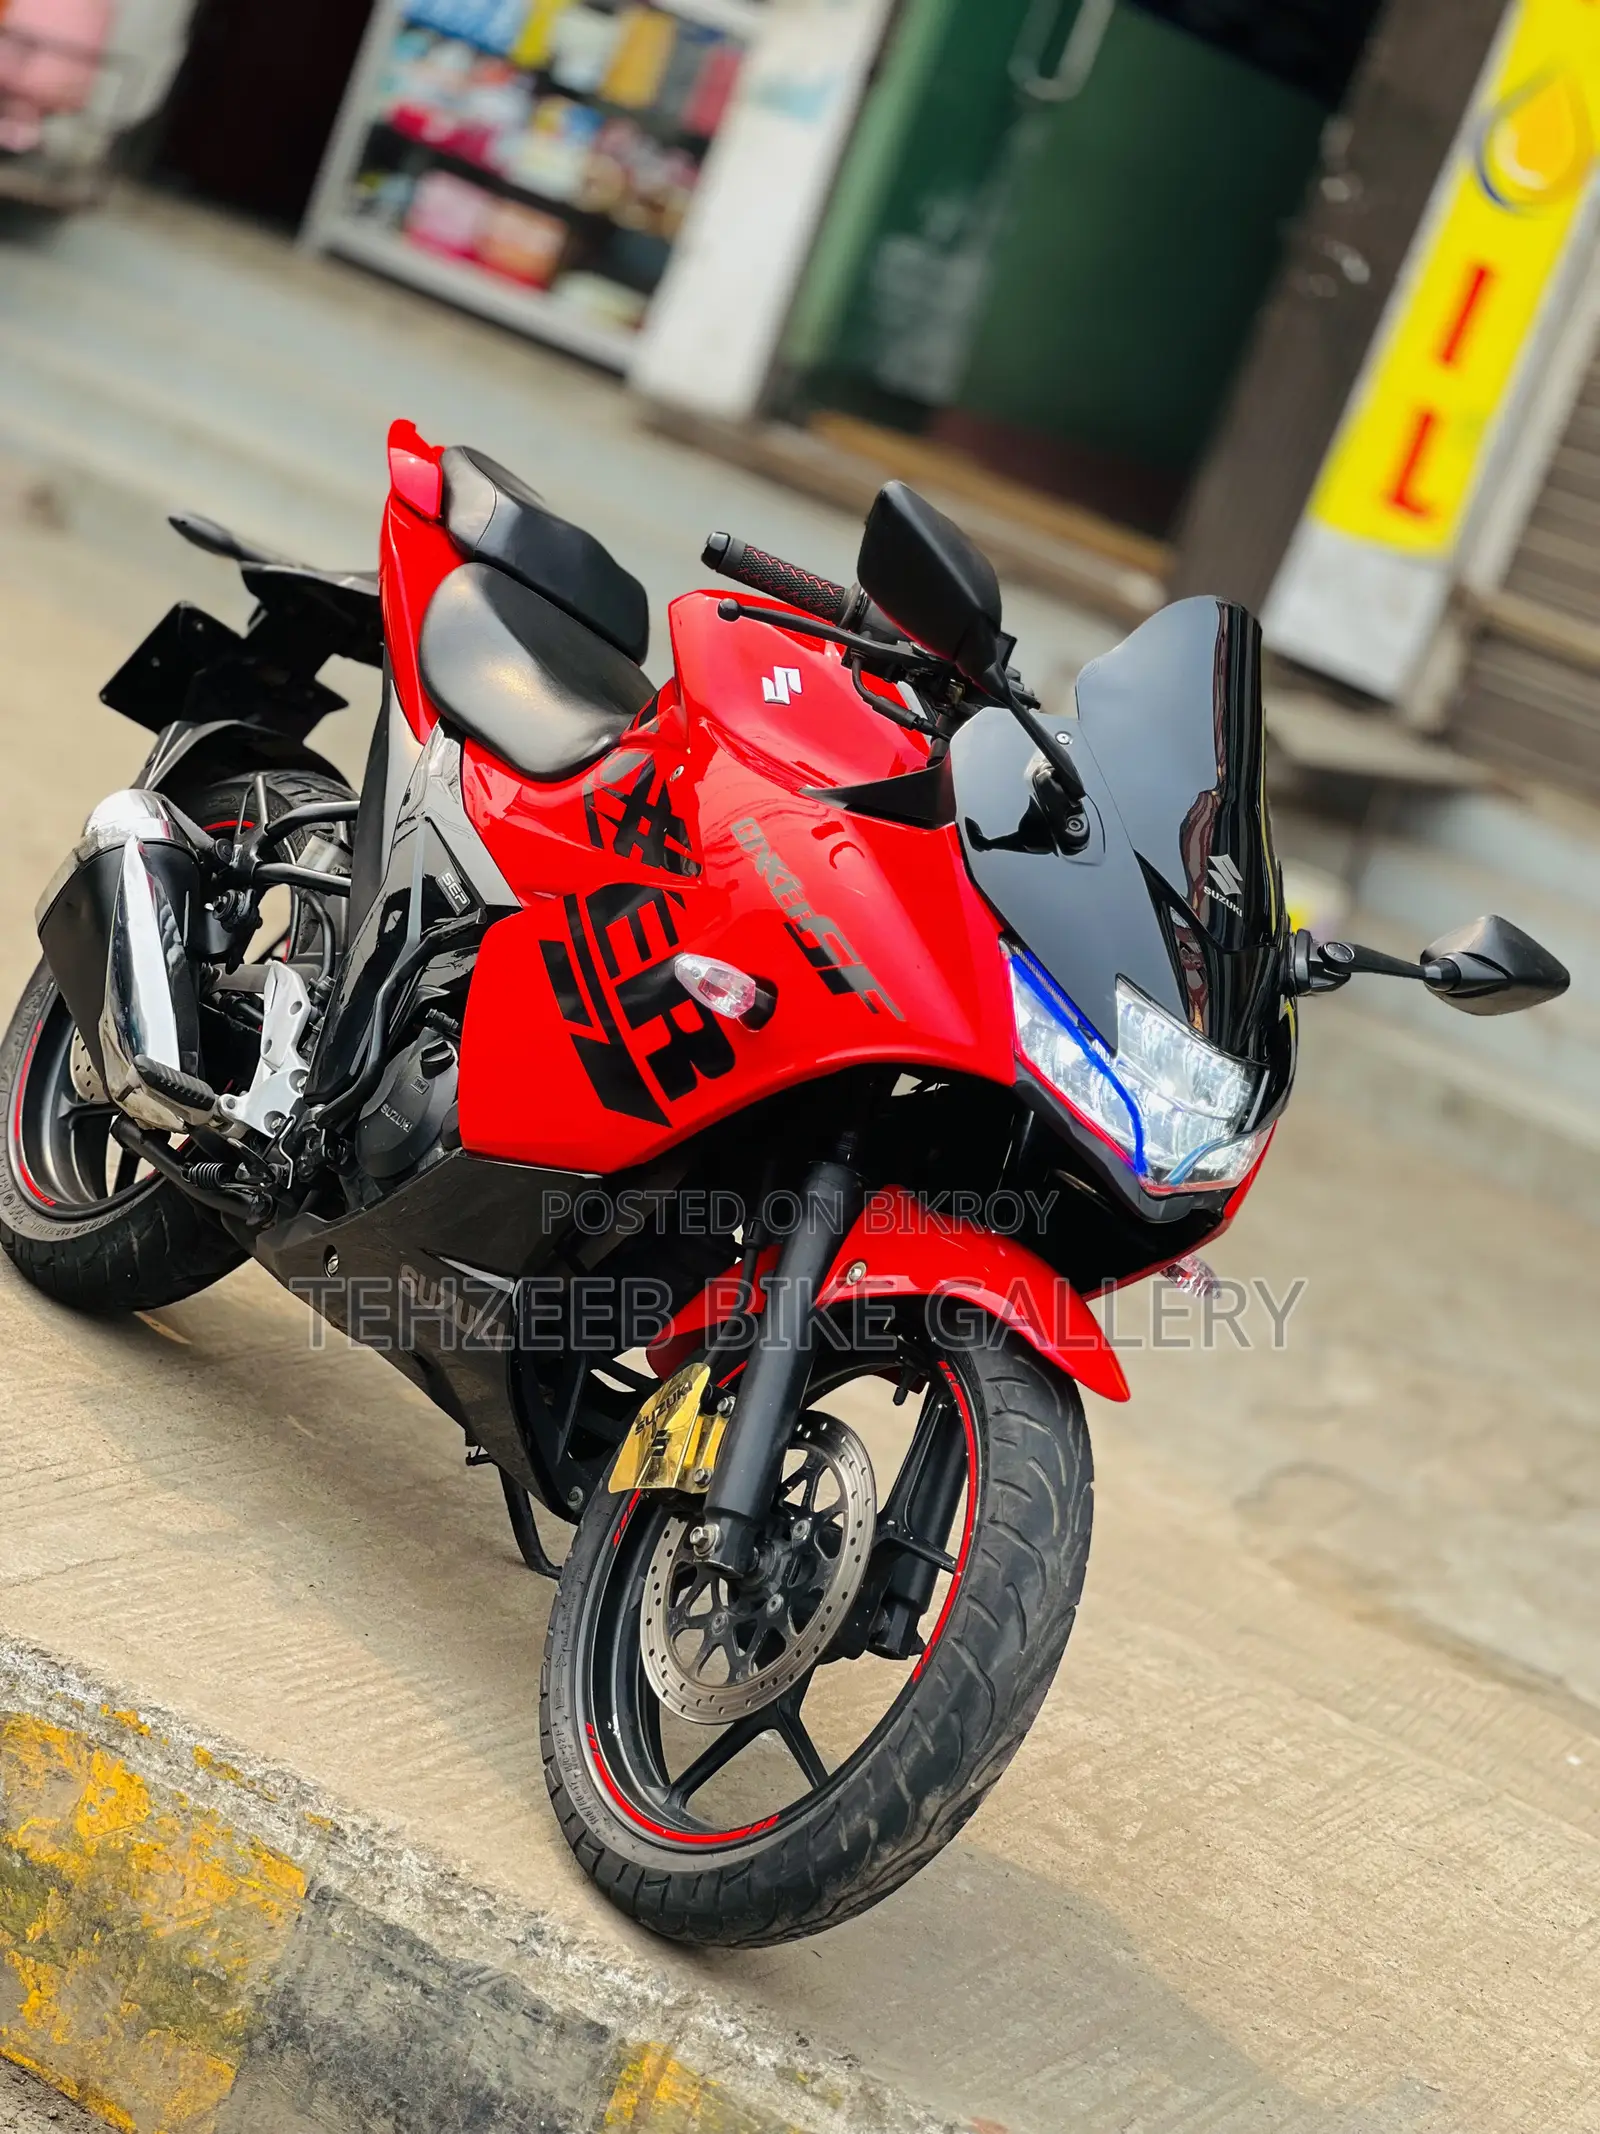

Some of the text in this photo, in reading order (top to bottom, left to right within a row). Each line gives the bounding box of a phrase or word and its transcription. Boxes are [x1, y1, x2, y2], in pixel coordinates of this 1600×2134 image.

[441, 872, 468, 905] SEP
[1203, 886, 1243, 918] SUZUKI
[783, 914, 906, 1022] SF
[380, 1103, 413, 1133] SUZUKI
[399, 1264, 506, 1353] SUZUKI
[634, 1381, 693, 1436] SUZUKI
